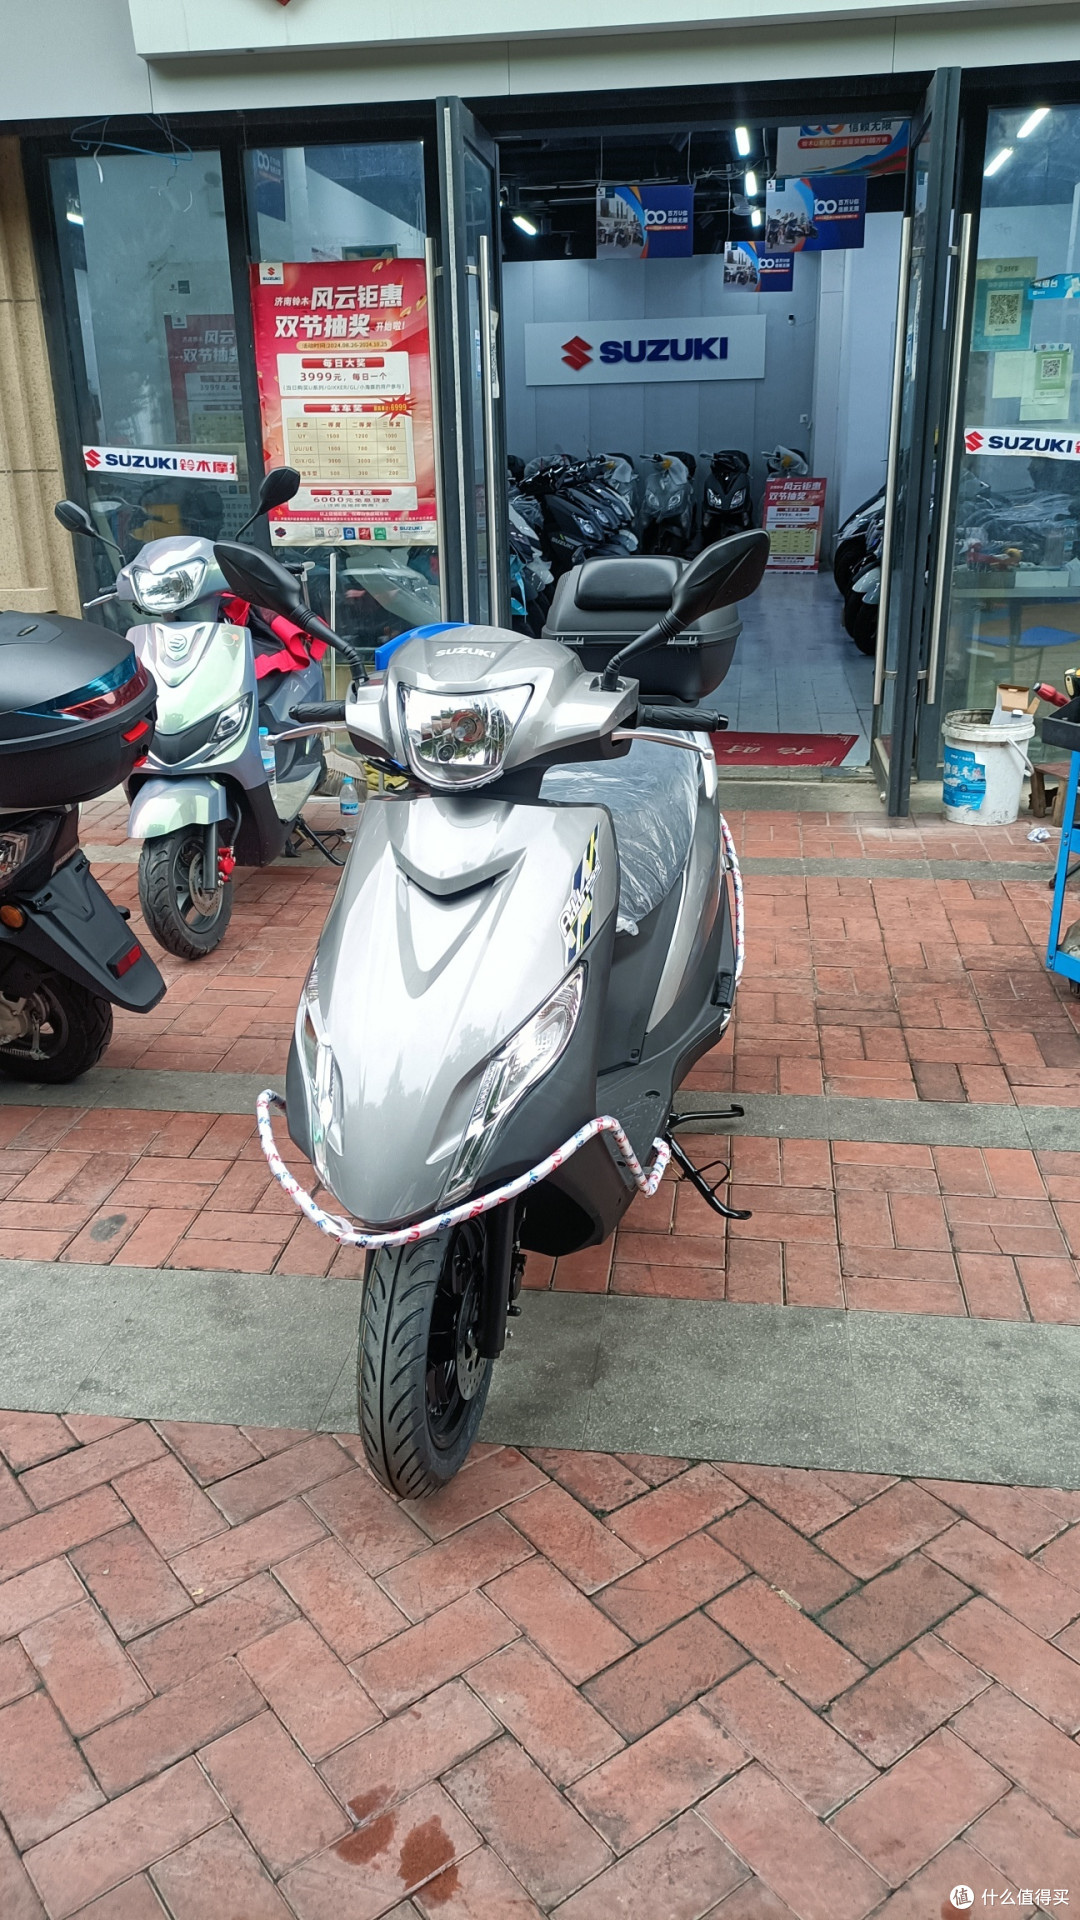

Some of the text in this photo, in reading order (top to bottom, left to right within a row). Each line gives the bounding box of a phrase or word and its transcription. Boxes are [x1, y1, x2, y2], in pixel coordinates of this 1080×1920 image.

[644, 209, 667, 224] 100
[310, 284, 404, 310] 风云钜惠
[274, 314, 371, 338] 双节抽奖
[600, 336, 728, 363] SUZUKI
[322, 358, 366, 368] 每日大奖
[987, 435, 1074, 454] SUZUKI
[105, 453, 177, 470] SUZUKI
[435, 646, 497, 659] SUZUKI
